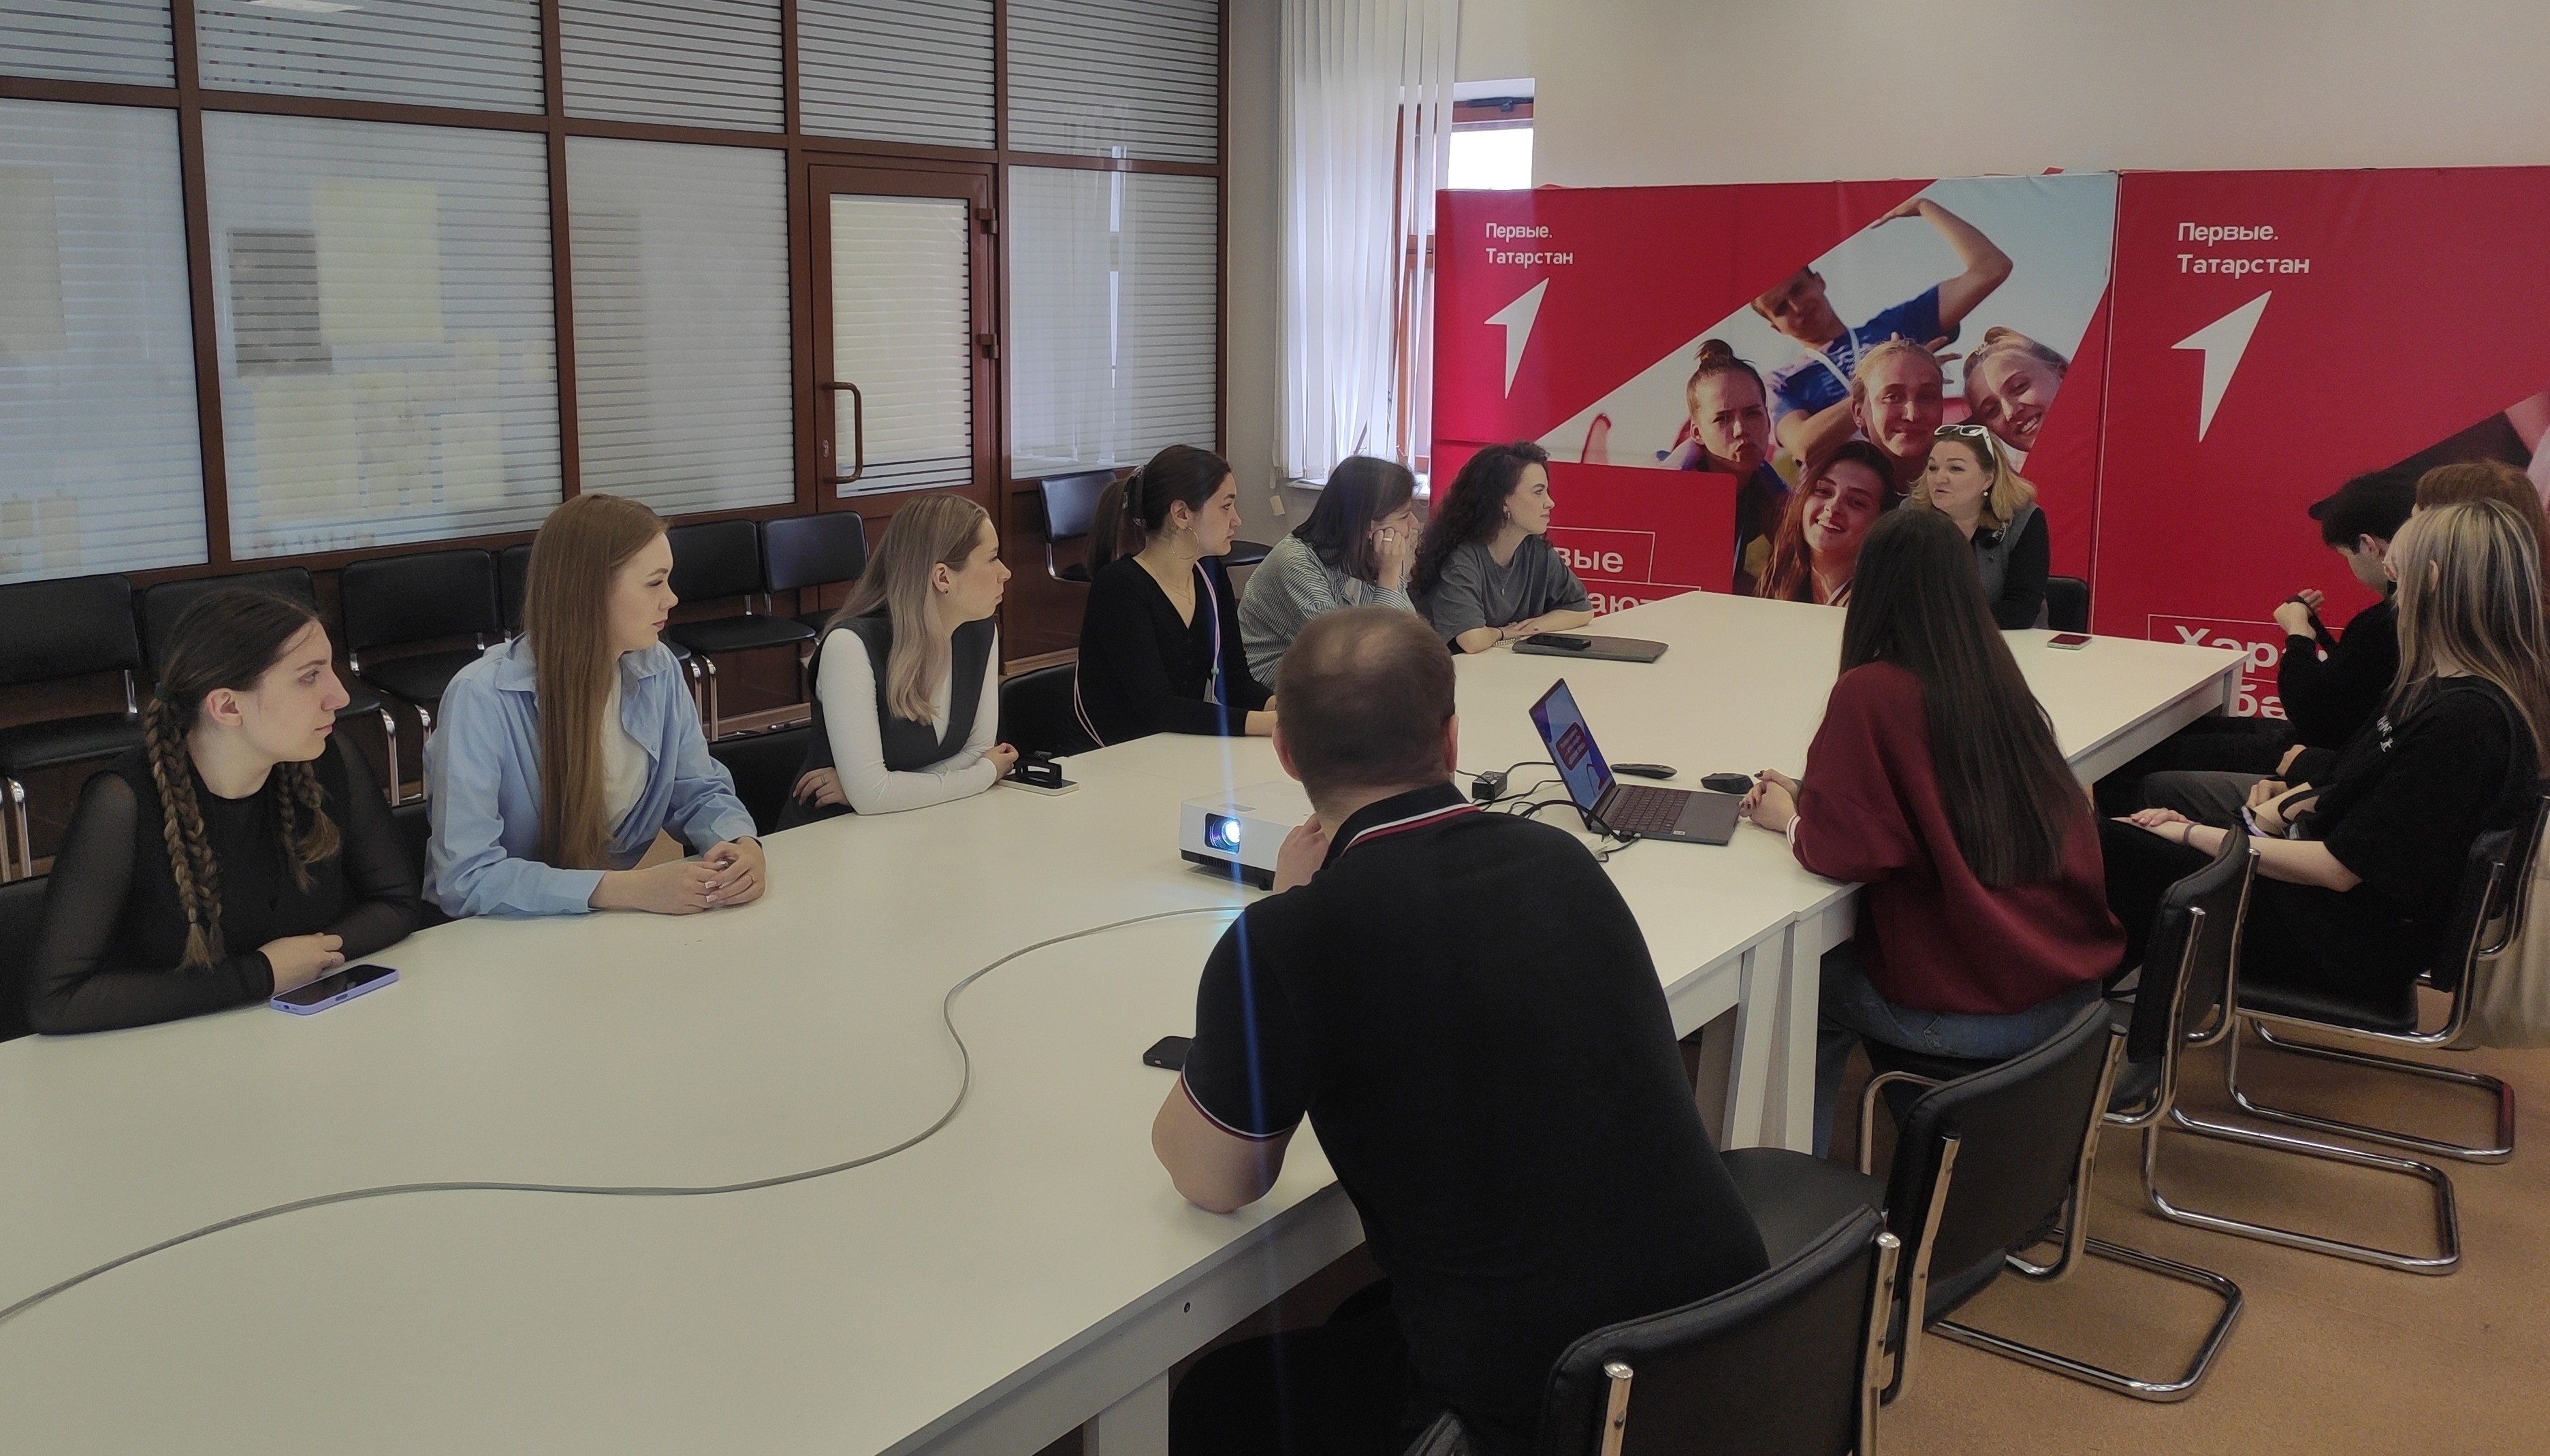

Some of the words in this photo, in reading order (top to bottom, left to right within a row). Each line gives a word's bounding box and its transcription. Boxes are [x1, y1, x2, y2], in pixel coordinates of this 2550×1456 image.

[1486, 223, 1552, 243] Первые.
[2178, 223, 2278, 246] Первые.
[1485, 248, 1574, 269] Татарстан
[2177, 254, 2310, 279] Татарстан
